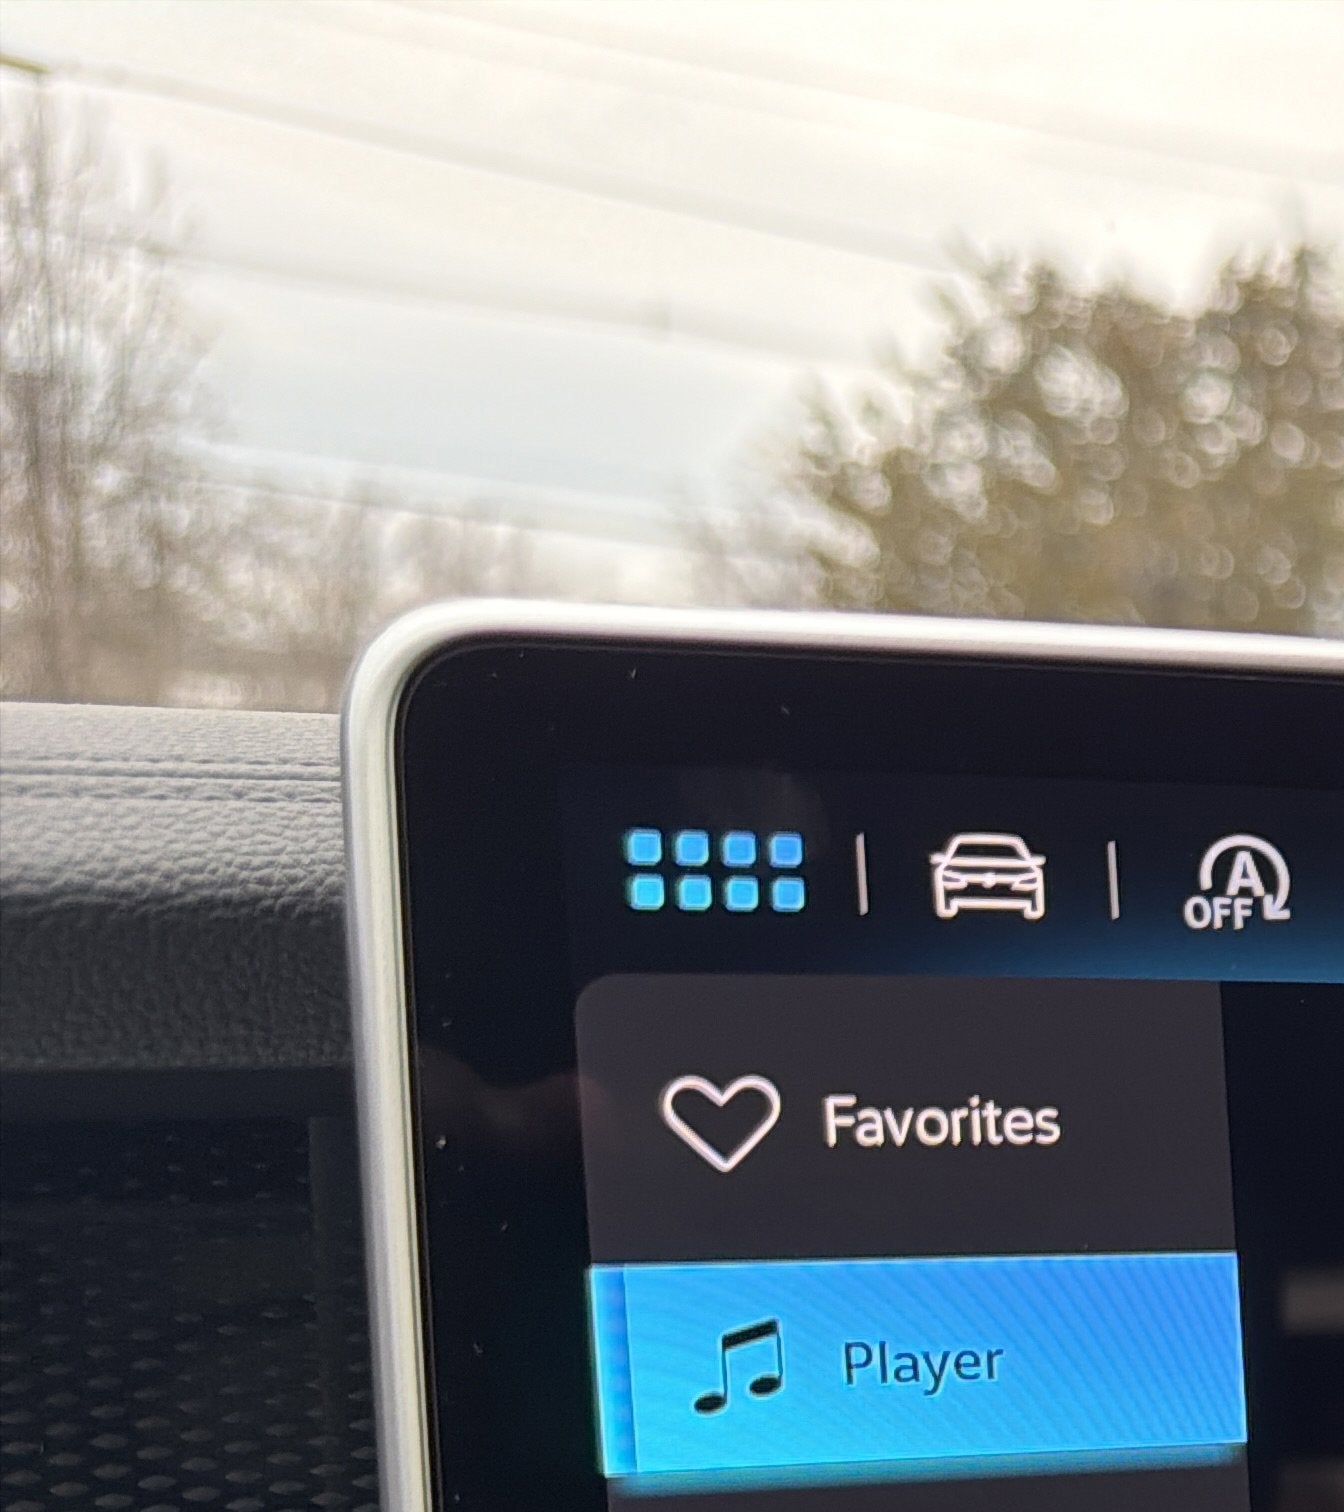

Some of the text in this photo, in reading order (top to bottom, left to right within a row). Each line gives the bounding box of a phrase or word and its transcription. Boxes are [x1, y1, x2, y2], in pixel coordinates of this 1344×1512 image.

[1183, 896, 1253, 931] OFF
[822, 1094, 1061, 1148] Favorites
[843, 1340, 1004, 1395] Player
